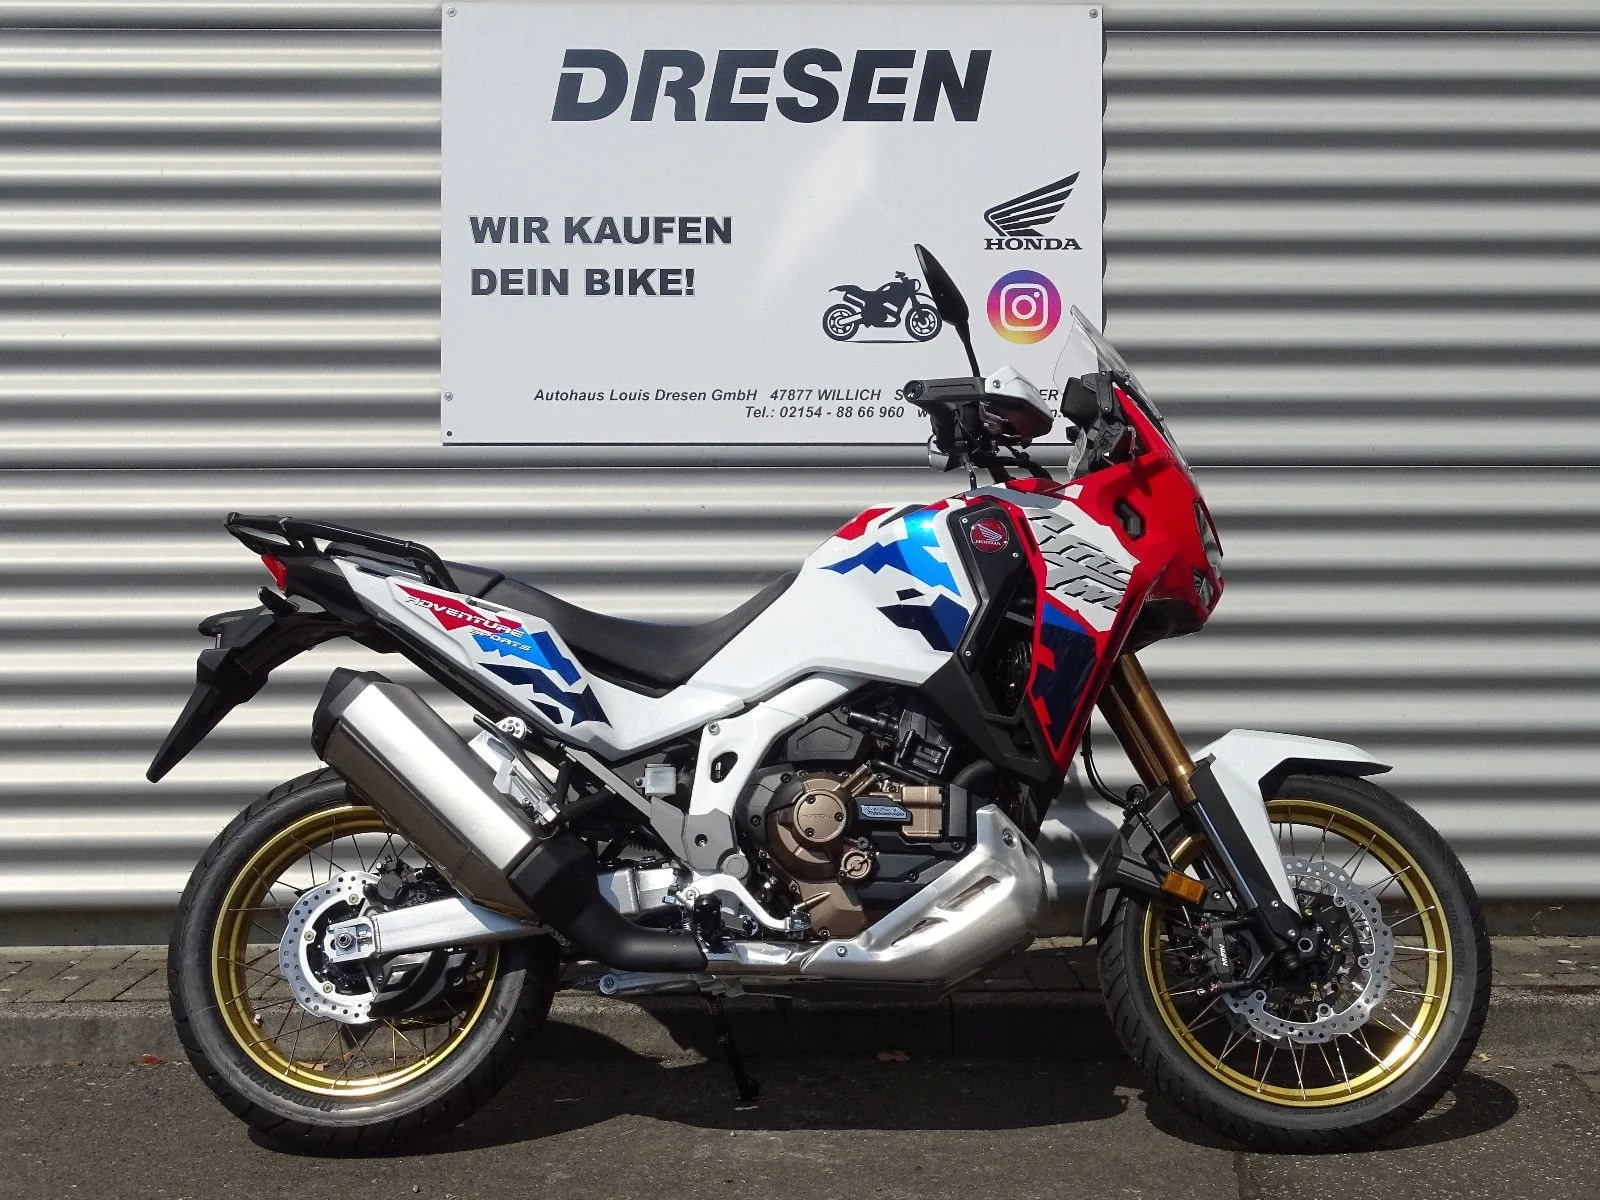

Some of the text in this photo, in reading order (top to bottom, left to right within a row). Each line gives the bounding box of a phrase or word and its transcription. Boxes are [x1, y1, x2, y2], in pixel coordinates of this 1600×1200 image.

[551, 47, 993, 124] DRESEN
[469, 216, 732, 245] WIR KAUFEN
[984, 238, 1083, 251] HONDA
[471, 267, 695, 296] DEIN BIKE!
[534, 389, 605, 401] Autohaus
[610, 389, 650, 401] Louis
[654, 389, 707, 401] Dresen
[711, 389, 758, 401] GmbH
[770, 389, 814, 401] 47877
[818, 389, 882, 401] WILLICH
[745, 406, 775, 418] Tel.:
[779, 406, 823, 418] 02154
[836, 406, 854, 418] 88
[857, 406, 875, 418] 66
[879, 406, 905, 418] 960
[405, 597, 525, 638] ADVENTURE
[469, 628, 532, 652] SPORTS
